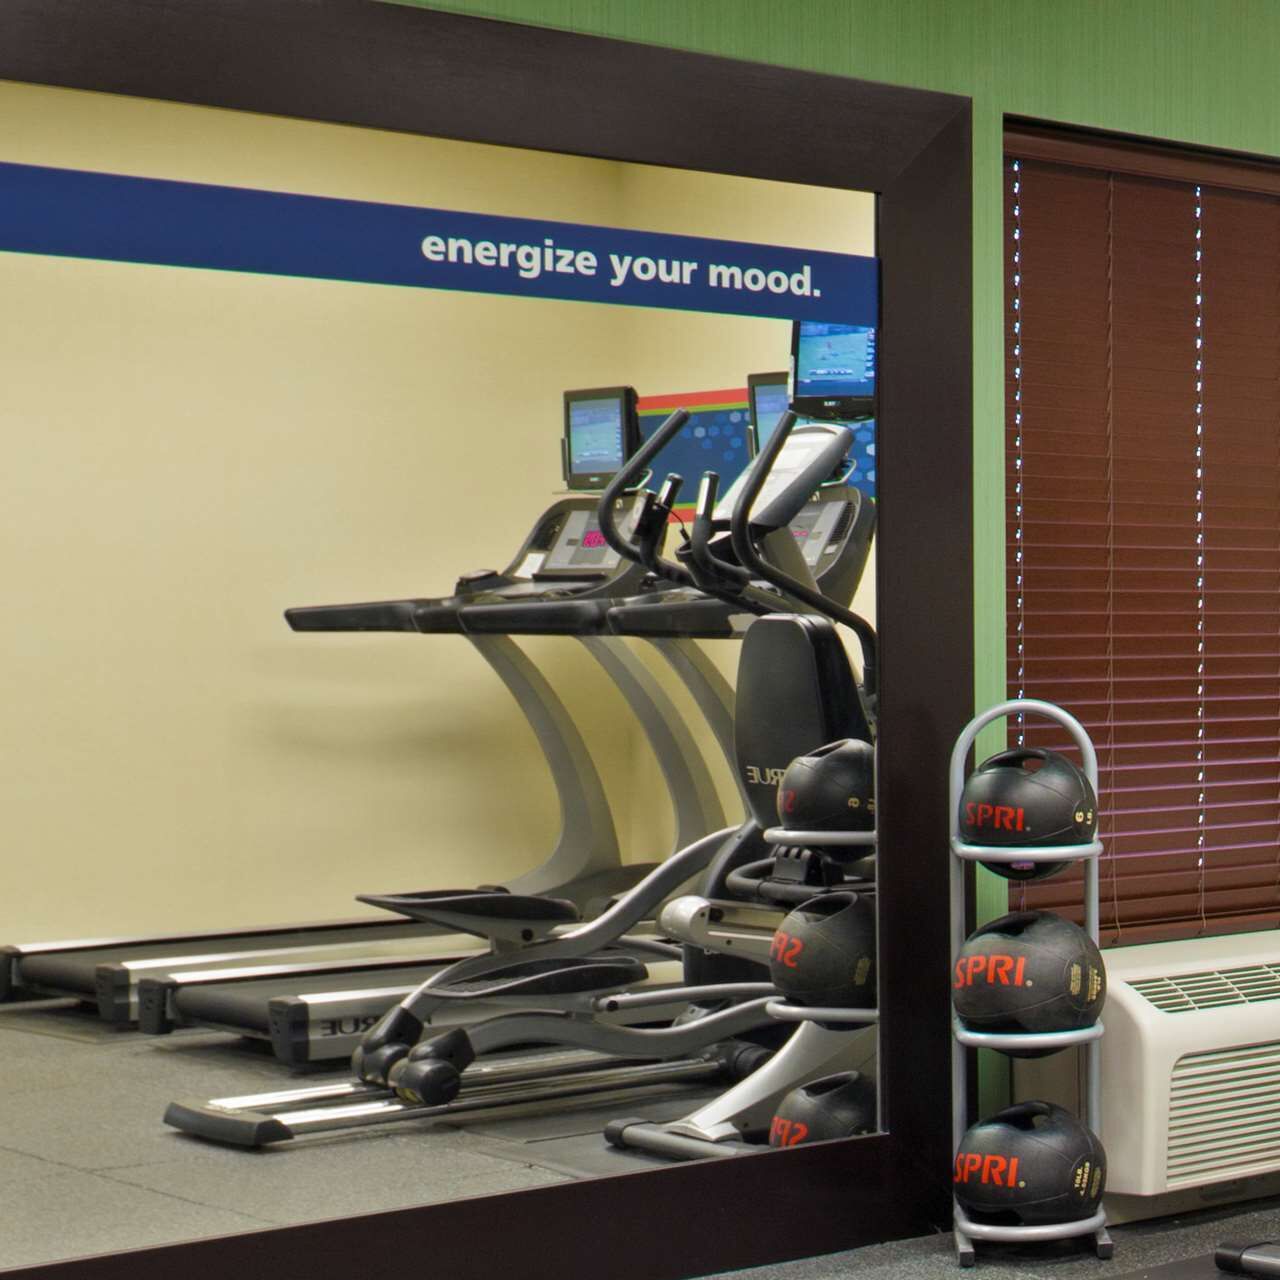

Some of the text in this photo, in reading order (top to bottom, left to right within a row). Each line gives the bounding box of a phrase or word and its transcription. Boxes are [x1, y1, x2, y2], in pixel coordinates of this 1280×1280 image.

[421, 234, 822, 297] energize your mood.
